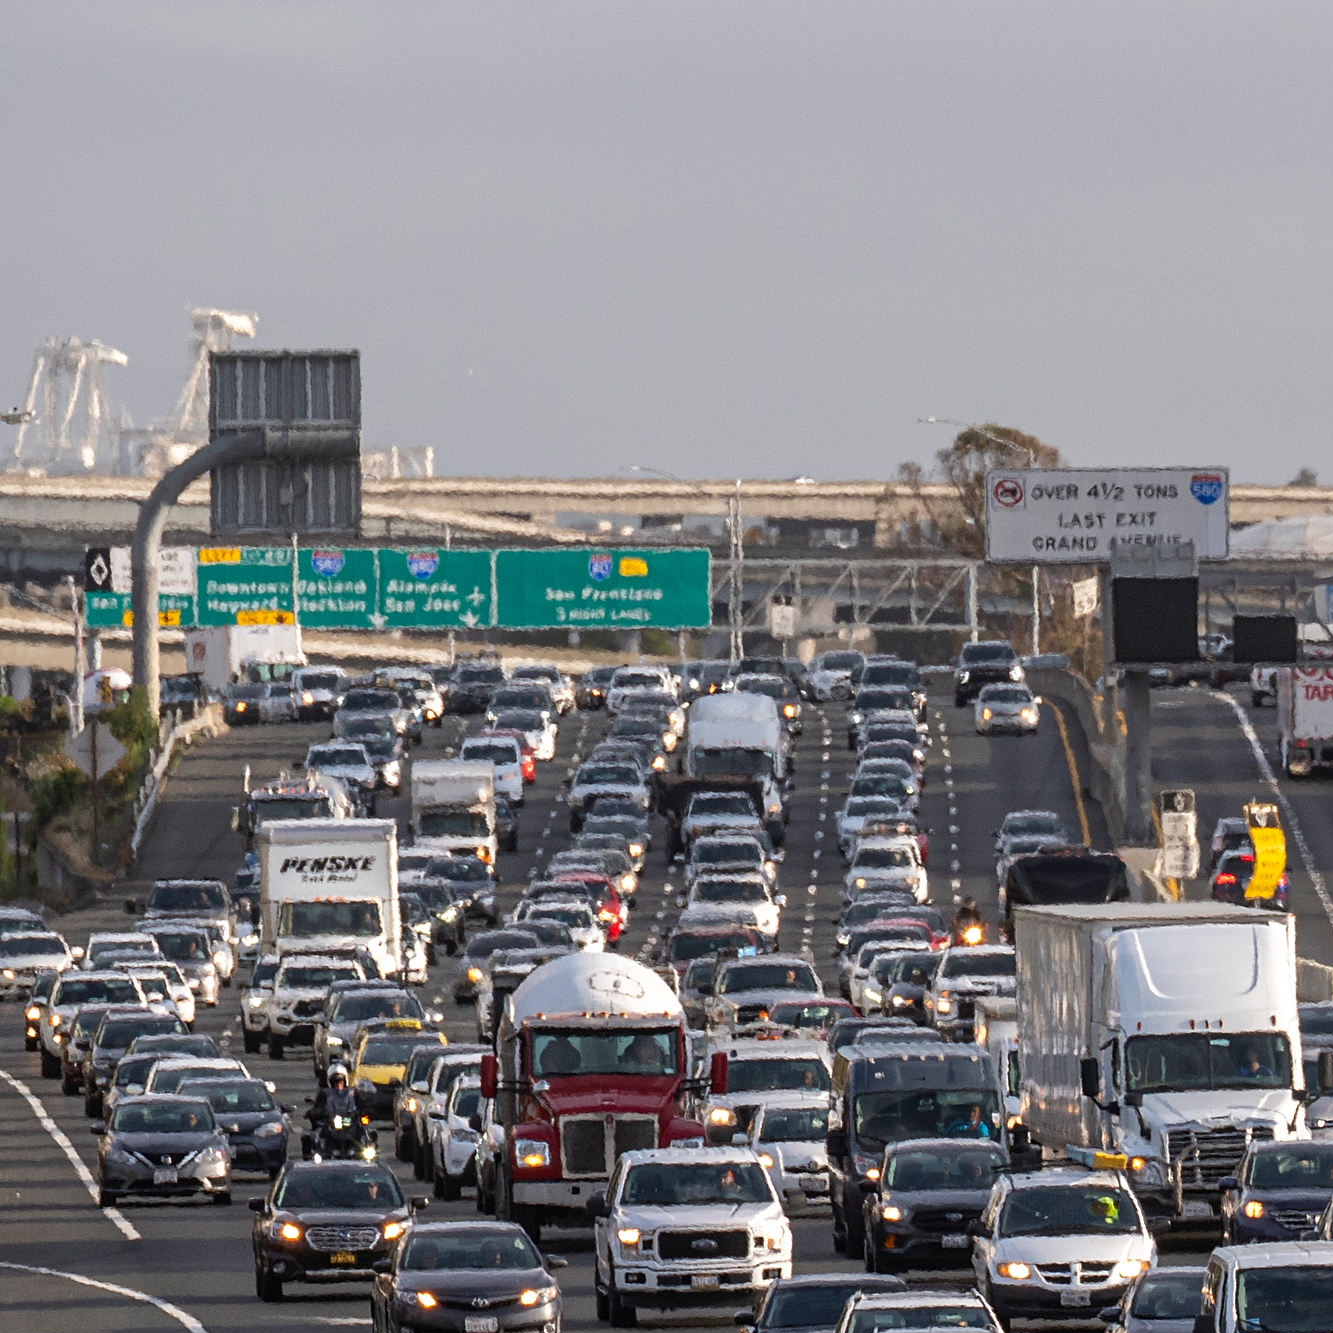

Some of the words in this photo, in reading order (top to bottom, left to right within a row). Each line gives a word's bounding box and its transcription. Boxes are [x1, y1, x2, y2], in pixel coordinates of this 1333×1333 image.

[1031, 484, 1078, 499] OVER
[1136, 484, 1178, 499] TONS
[1059, 512, 1105, 527] LAST
[1115, 511, 1156, 527] EXIT
[1033, 536, 1098, 551] GRAND
[280, 856, 376, 873] PENSKE
